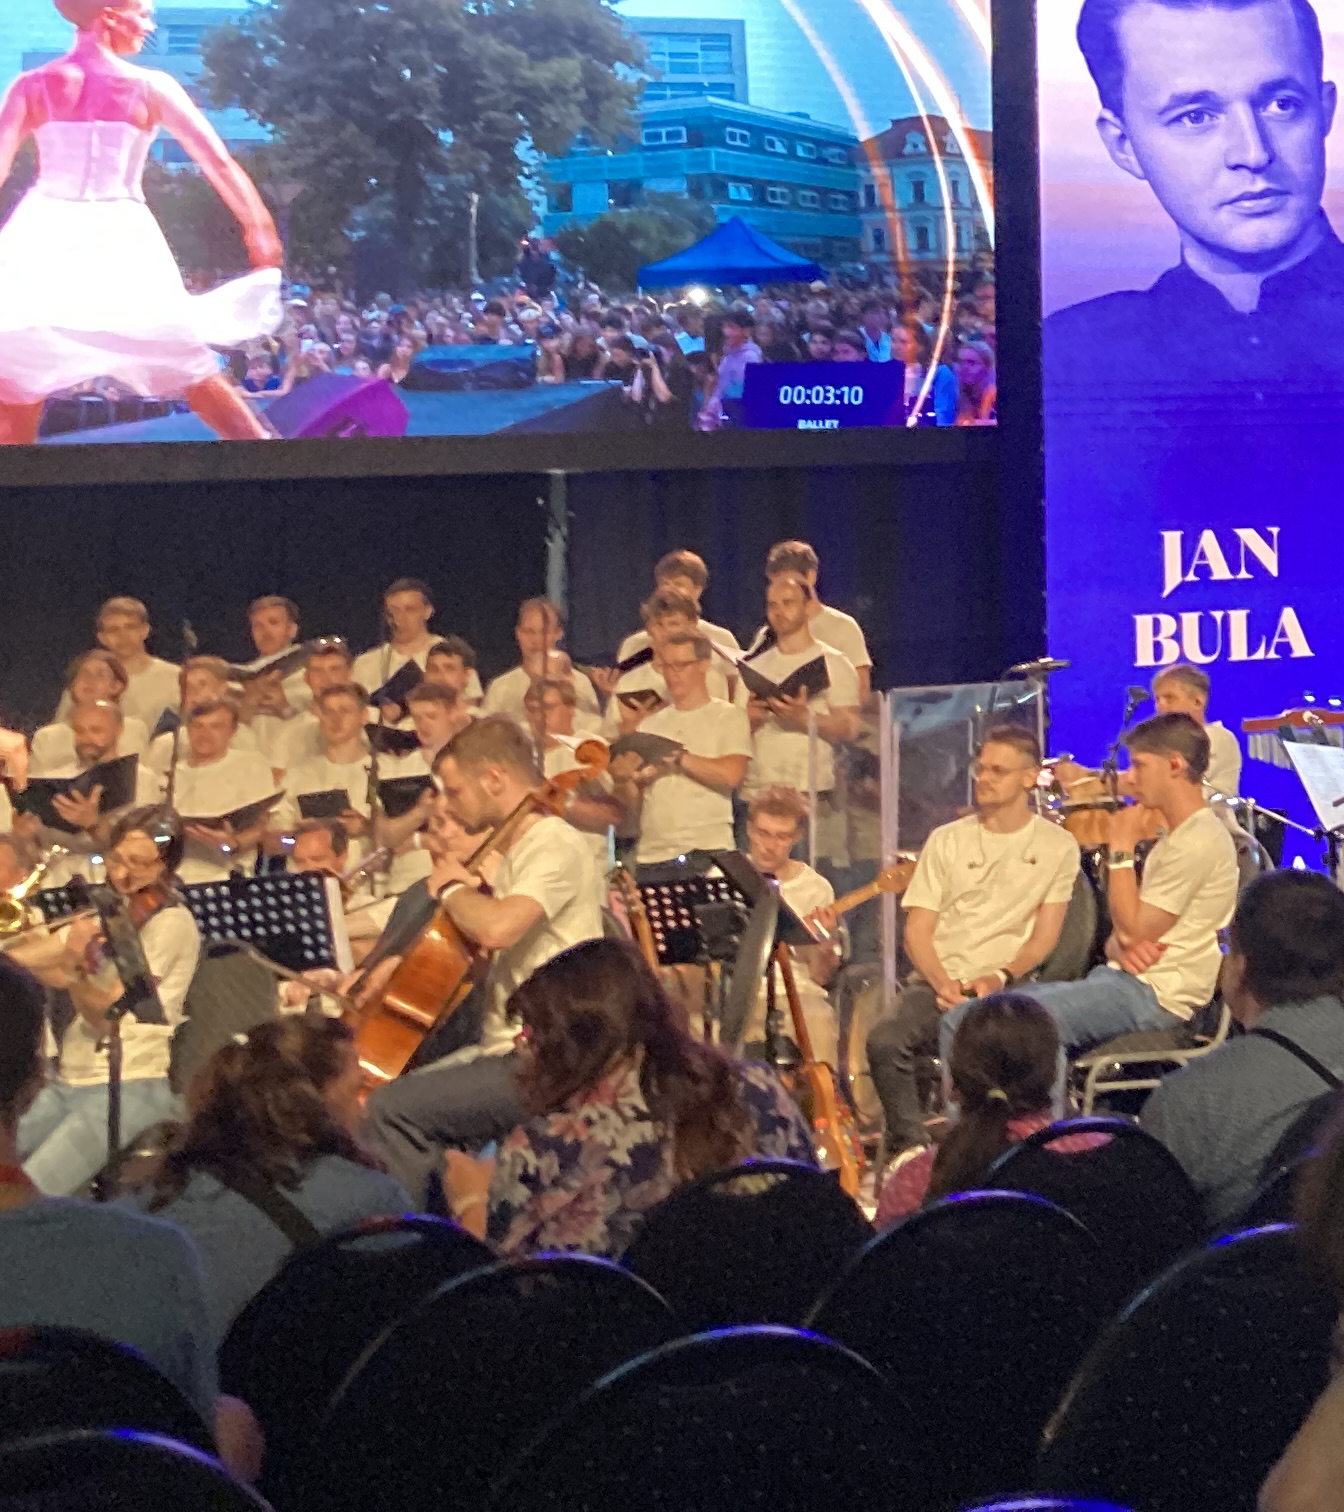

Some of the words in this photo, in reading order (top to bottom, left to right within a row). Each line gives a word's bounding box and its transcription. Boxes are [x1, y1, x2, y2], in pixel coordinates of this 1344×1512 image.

[779, 386, 863, 405] 00:03:10
[797, 419, 840, 429] BALLET
[1159, 526, 1280, 598] JAN
[1133, 605, 1315, 667] BULA
